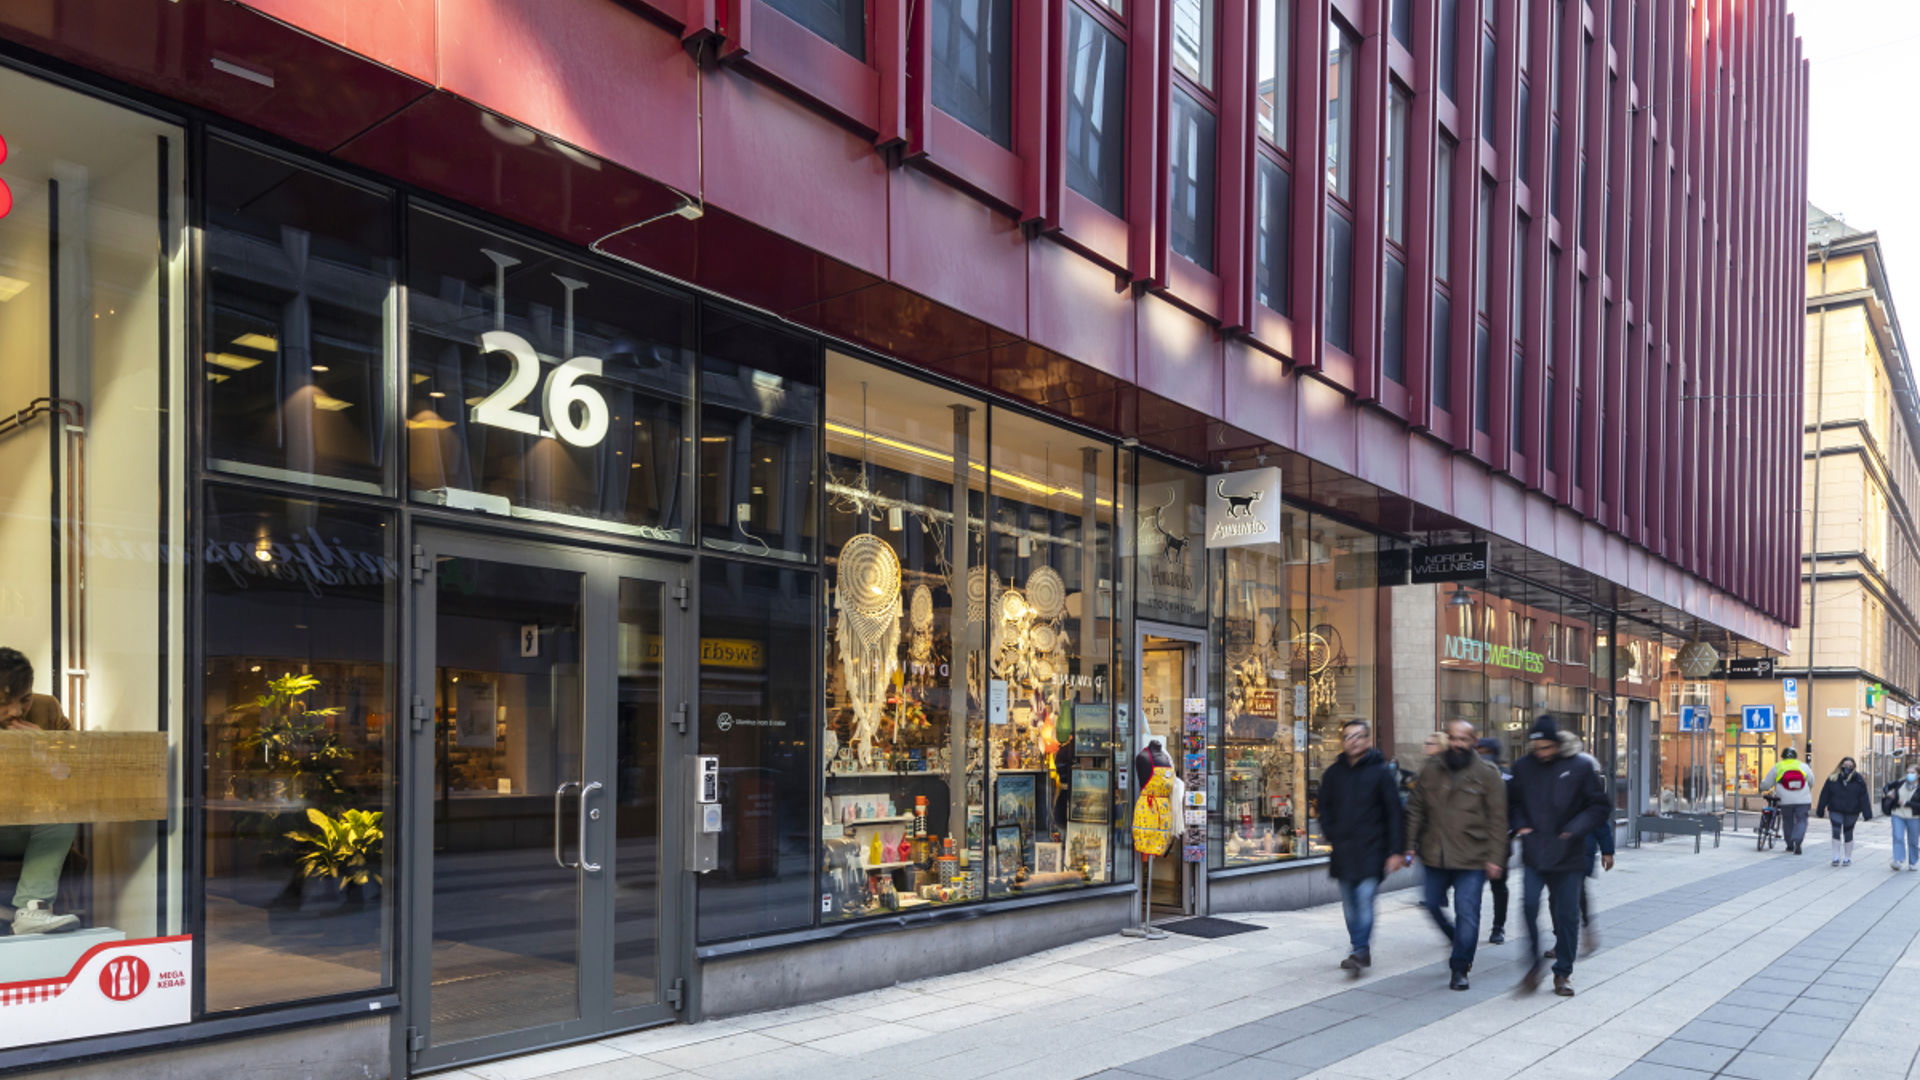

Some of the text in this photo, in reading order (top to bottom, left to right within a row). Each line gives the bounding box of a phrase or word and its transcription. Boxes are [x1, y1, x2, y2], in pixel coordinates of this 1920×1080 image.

[470, 331, 609, 447] 26
[1424, 553, 1473, 564] NORDIC
[1414, 561, 1486, 574] WELLNESS
[1445, 634, 1545, 674] NORDIC WELLNESS
[159, 970, 184, 980] MEGA
[157, 978, 186, 989] KEBAB
